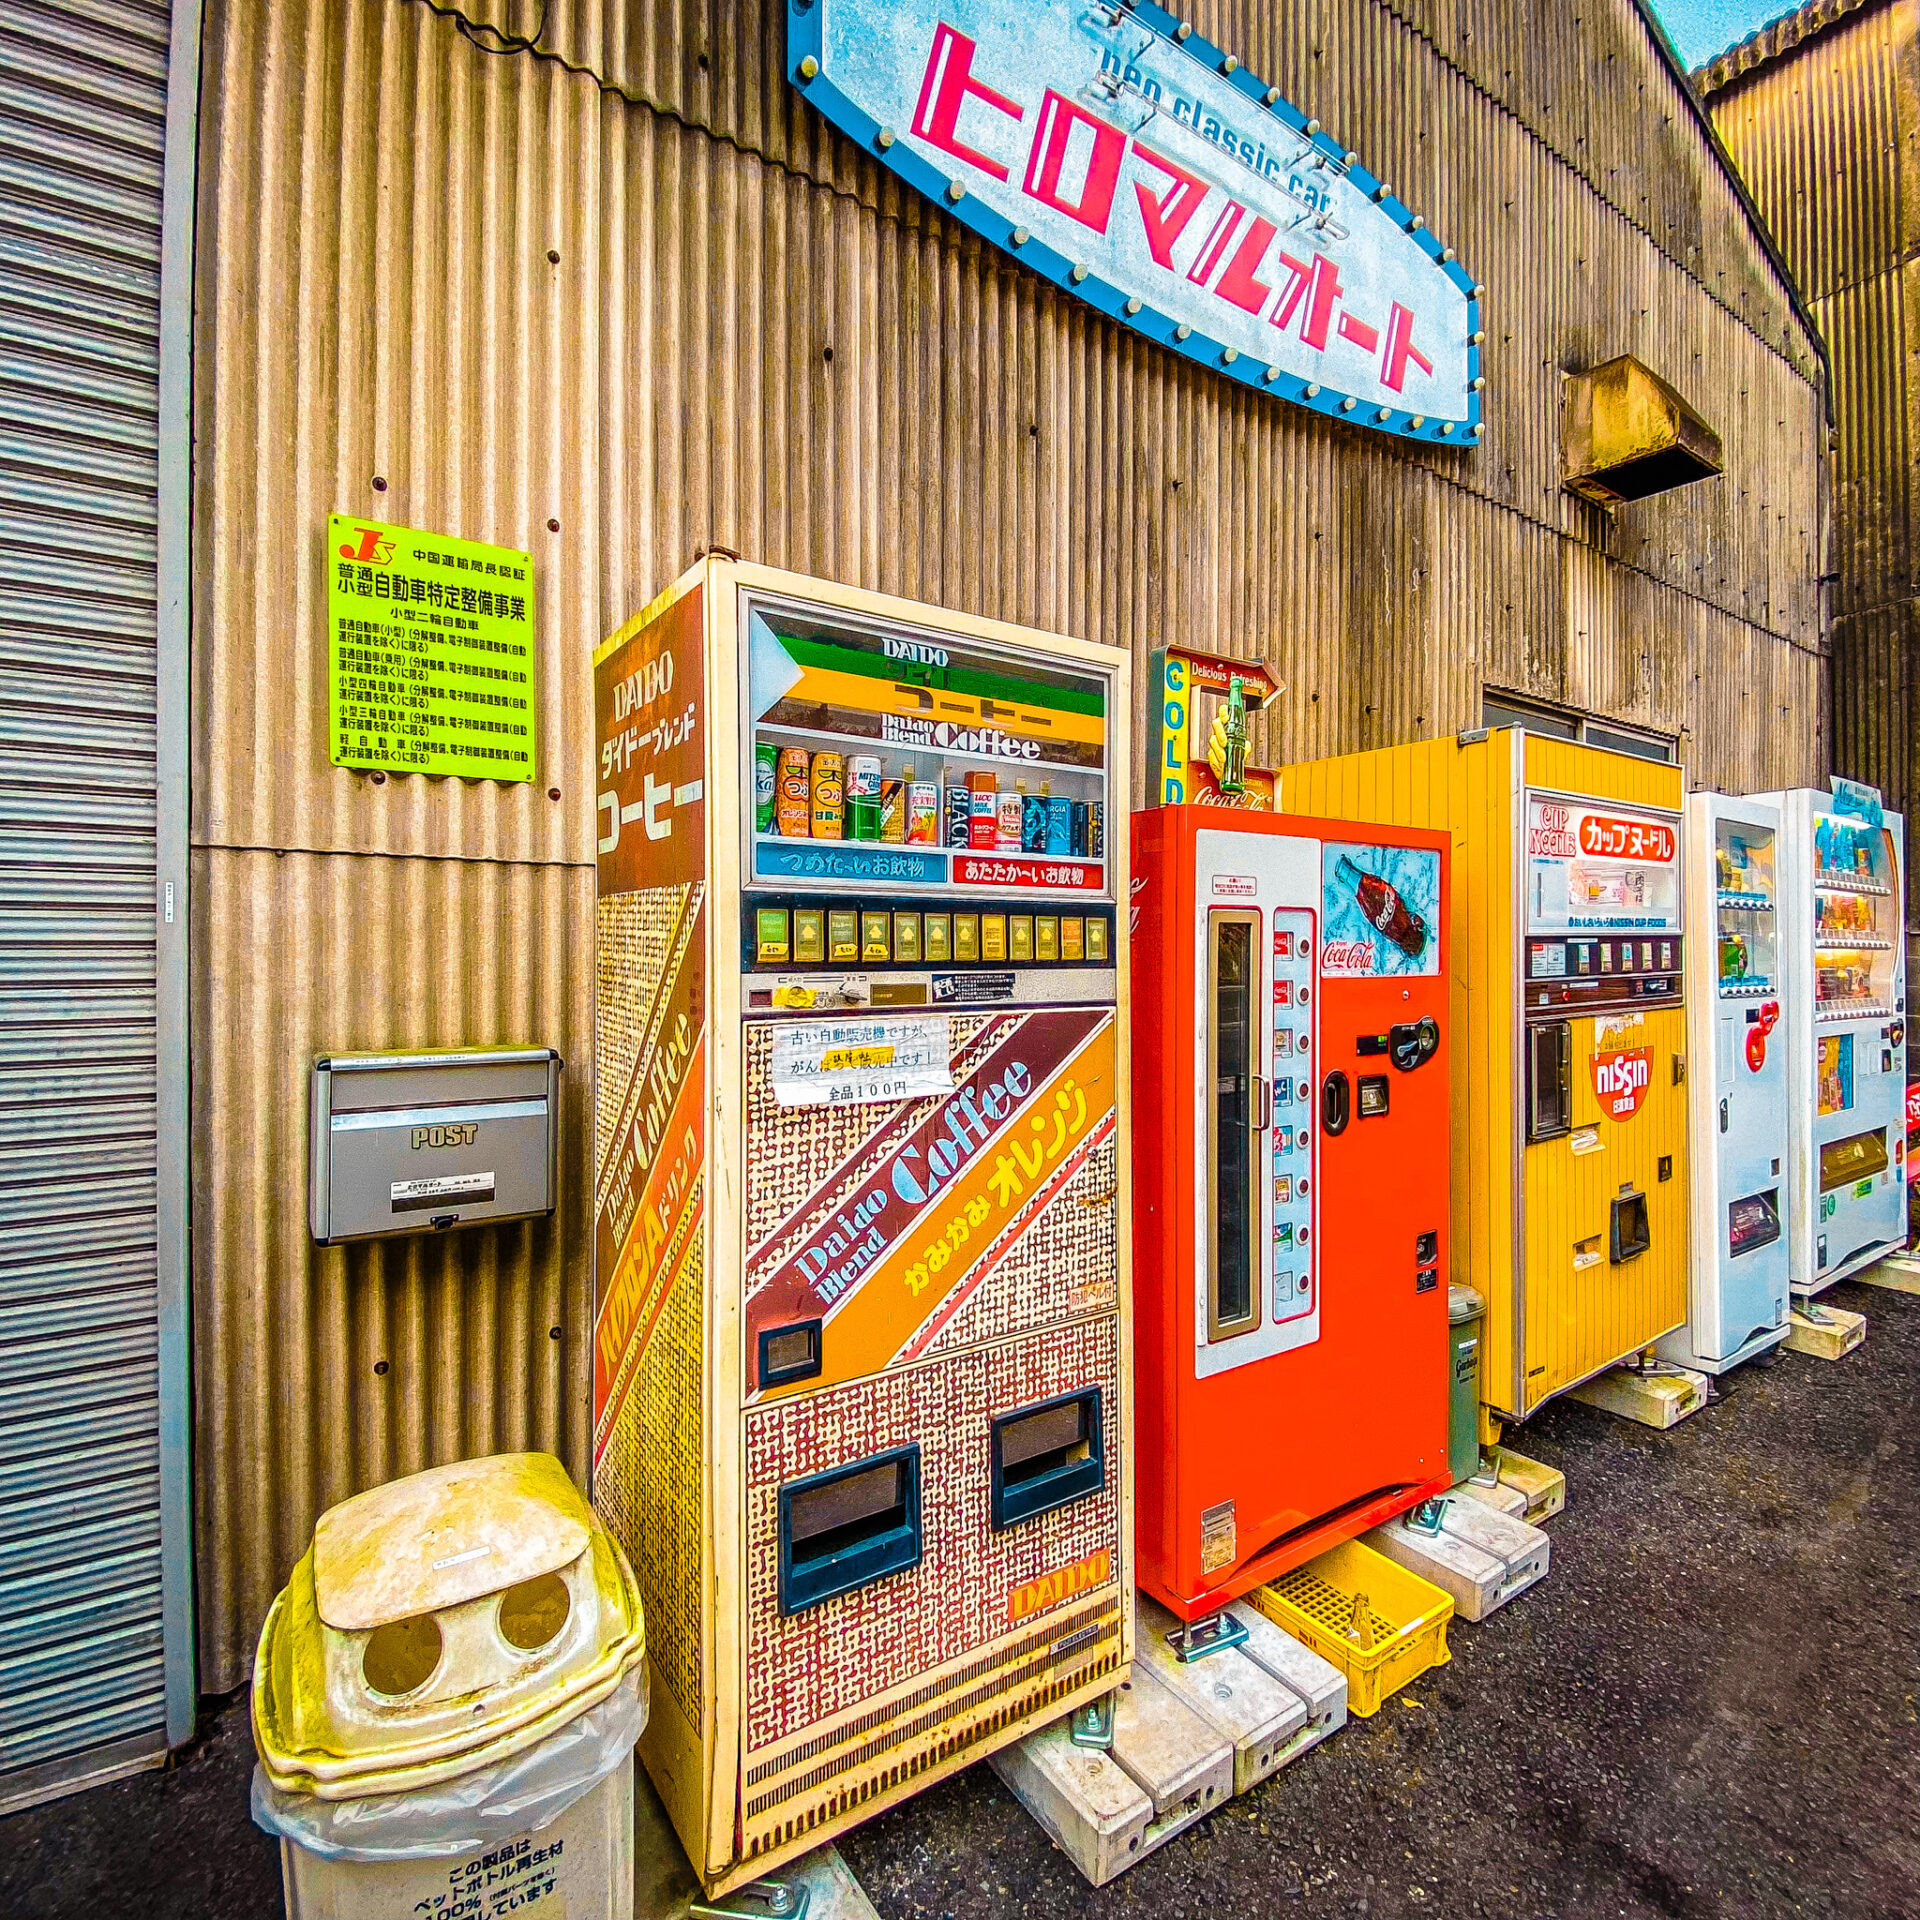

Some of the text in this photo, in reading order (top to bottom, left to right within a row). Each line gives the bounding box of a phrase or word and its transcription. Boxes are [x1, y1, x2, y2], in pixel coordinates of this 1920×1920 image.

[1173, 97, 1280, 181] classic
[1289, 173, 1331, 213] car
[910, 20, 1434, 394] ヒロマルオート
[337, 562, 373, 582] 普通
[337, 578, 373, 598] 小型
[413, 549, 525, 581] 中国運輸局長認証
[390, 608, 479, 631] 小型二輪自動車
[882, 638, 949, 667] DAIDO
[1192, 662, 1227, 682] Delicious
[612, 649, 675, 723] DAIDO
[601, 701, 696, 781] ダイドーブレンド
[881, 711, 1041, 760] Daido Coffee
[1164, 661, 1184, 804] COLD
[597, 773, 703, 855] コーヒー
[951, 788, 969, 848] BLACK
[1541, 804, 1569, 832] CUP
[1585, 818, 1672, 858] カップヌードル
[1322, 942, 1374, 969] Coca-Cola
[634, 1010, 693, 1170] Coffee
[411, 1123, 479, 1150] POST
[891, 1061, 1032, 1204] Coffee
[793, 1188, 888, 1287] Daido
[814, 1225, 889, 1305] Blend
[1012, 1552, 1110, 1619] DAIDO
[414, 1839, 564, 1913] ペットボトル再生材
[450, 1839, 532, 1884] この製品は
